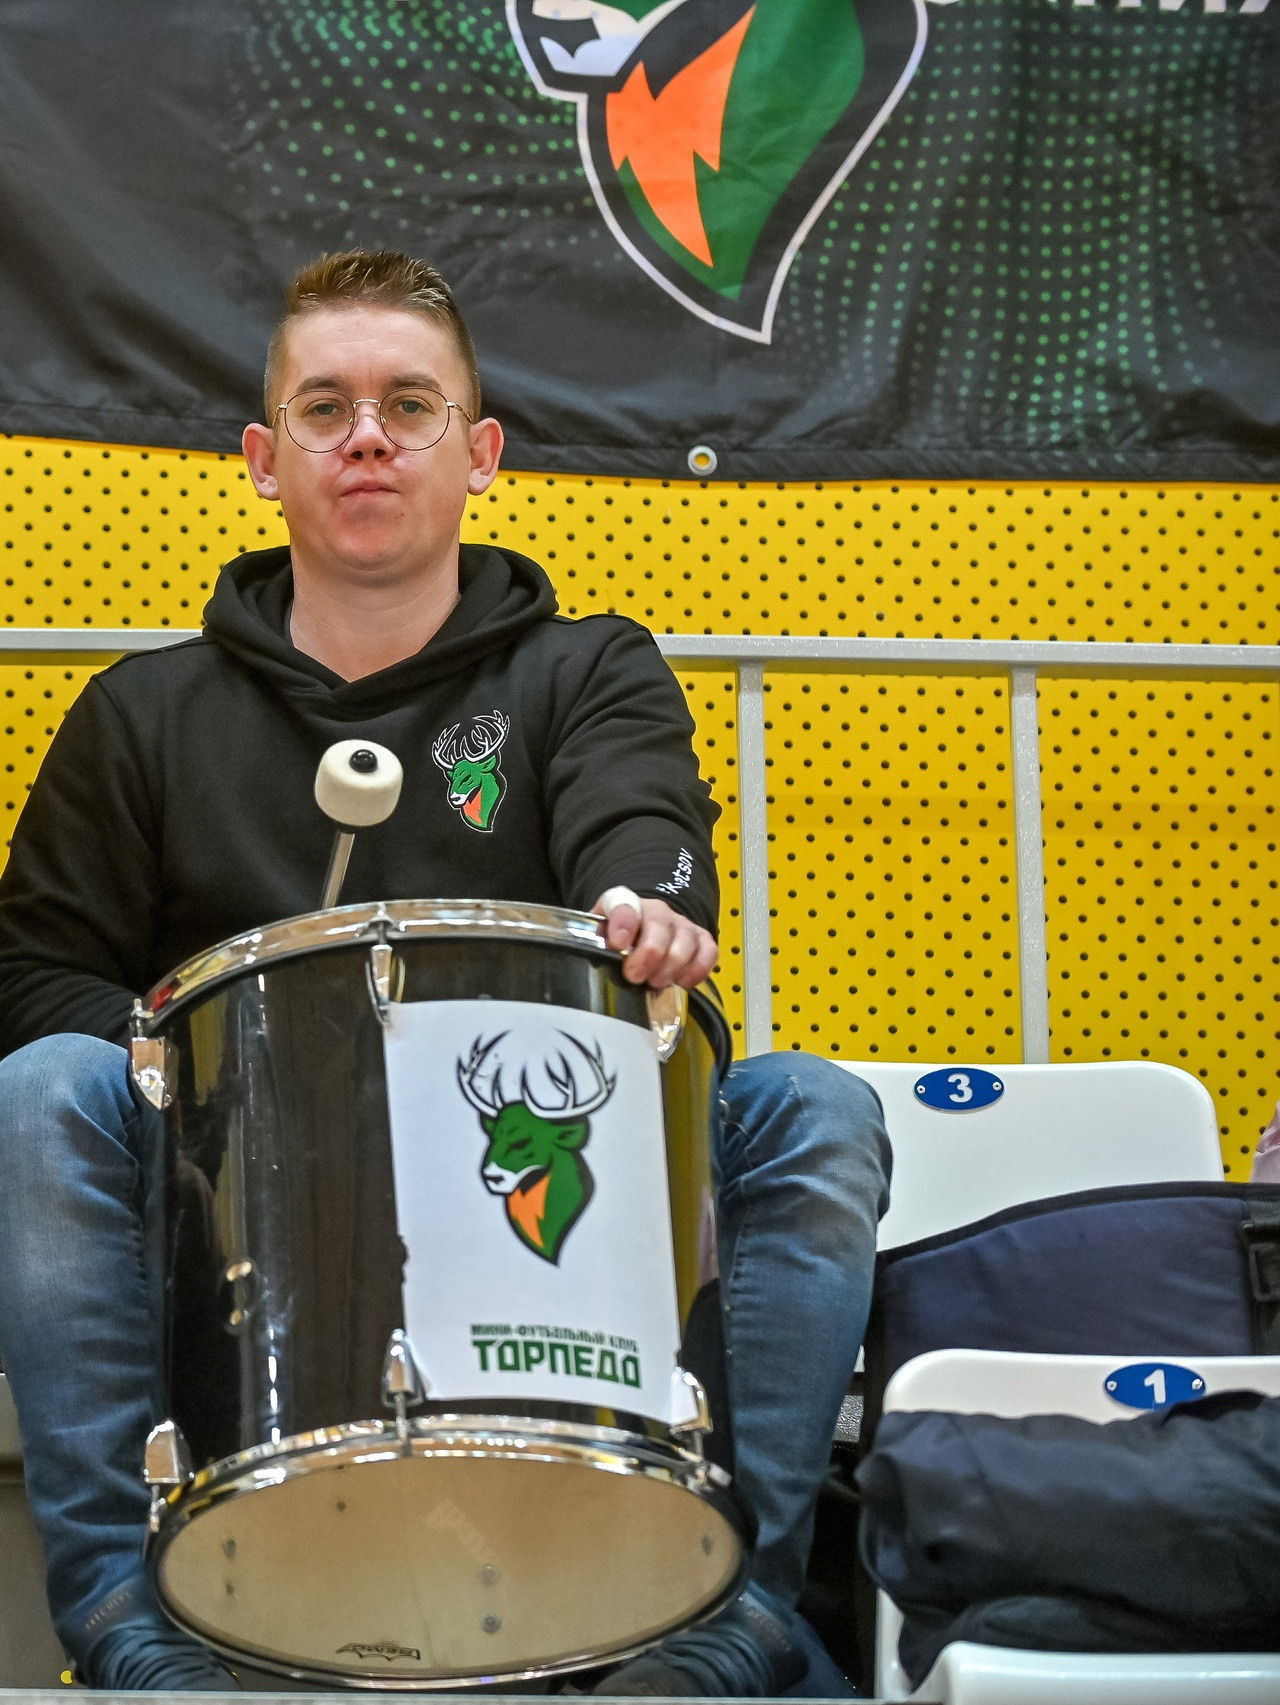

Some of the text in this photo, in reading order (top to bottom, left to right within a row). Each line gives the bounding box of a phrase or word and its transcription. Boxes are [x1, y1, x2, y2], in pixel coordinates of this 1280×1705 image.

[947, 1073, 974, 1103] 3
[472, 1339, 641, 1388] ТОРПЕДО
[1144, 1369, 1166, 1404] 1
